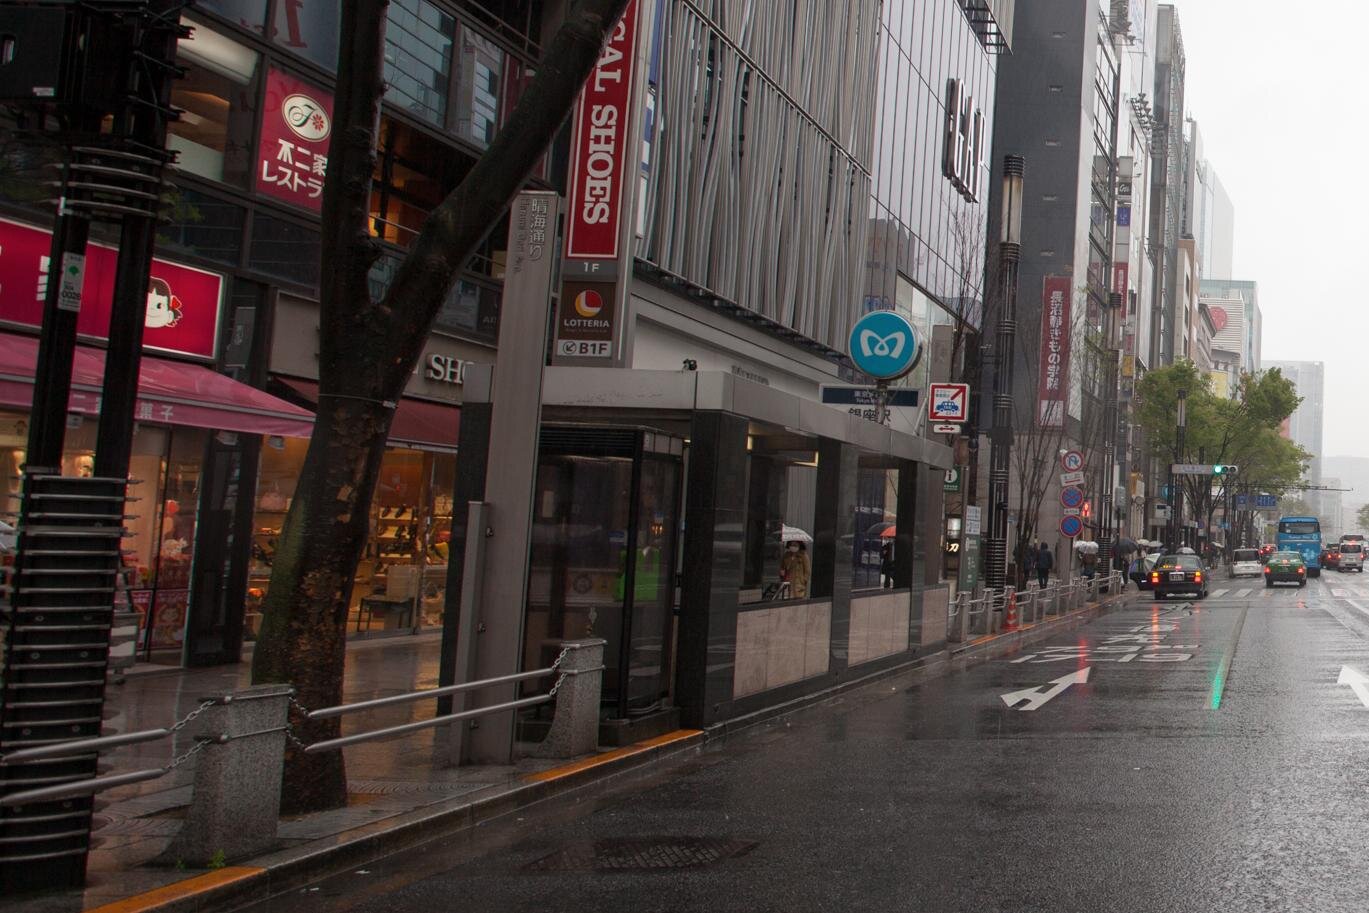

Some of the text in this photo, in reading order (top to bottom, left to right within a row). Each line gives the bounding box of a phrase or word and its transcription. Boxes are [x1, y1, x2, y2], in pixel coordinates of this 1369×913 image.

[277, 138, 328, 177] 不二家
[953, 79, 985, 201] GAP
[262, 160, 325, 198] レストラ
[582, 104, 618, 224] SHOES
[529, 198, 549, 262] 晴海通り
[584, 262, 600, 273] 1F
[563, 318, 611, 329] LOTTERIA
[579, 342, 608, 355] B1F
[430, 354, 475, 384] SH
